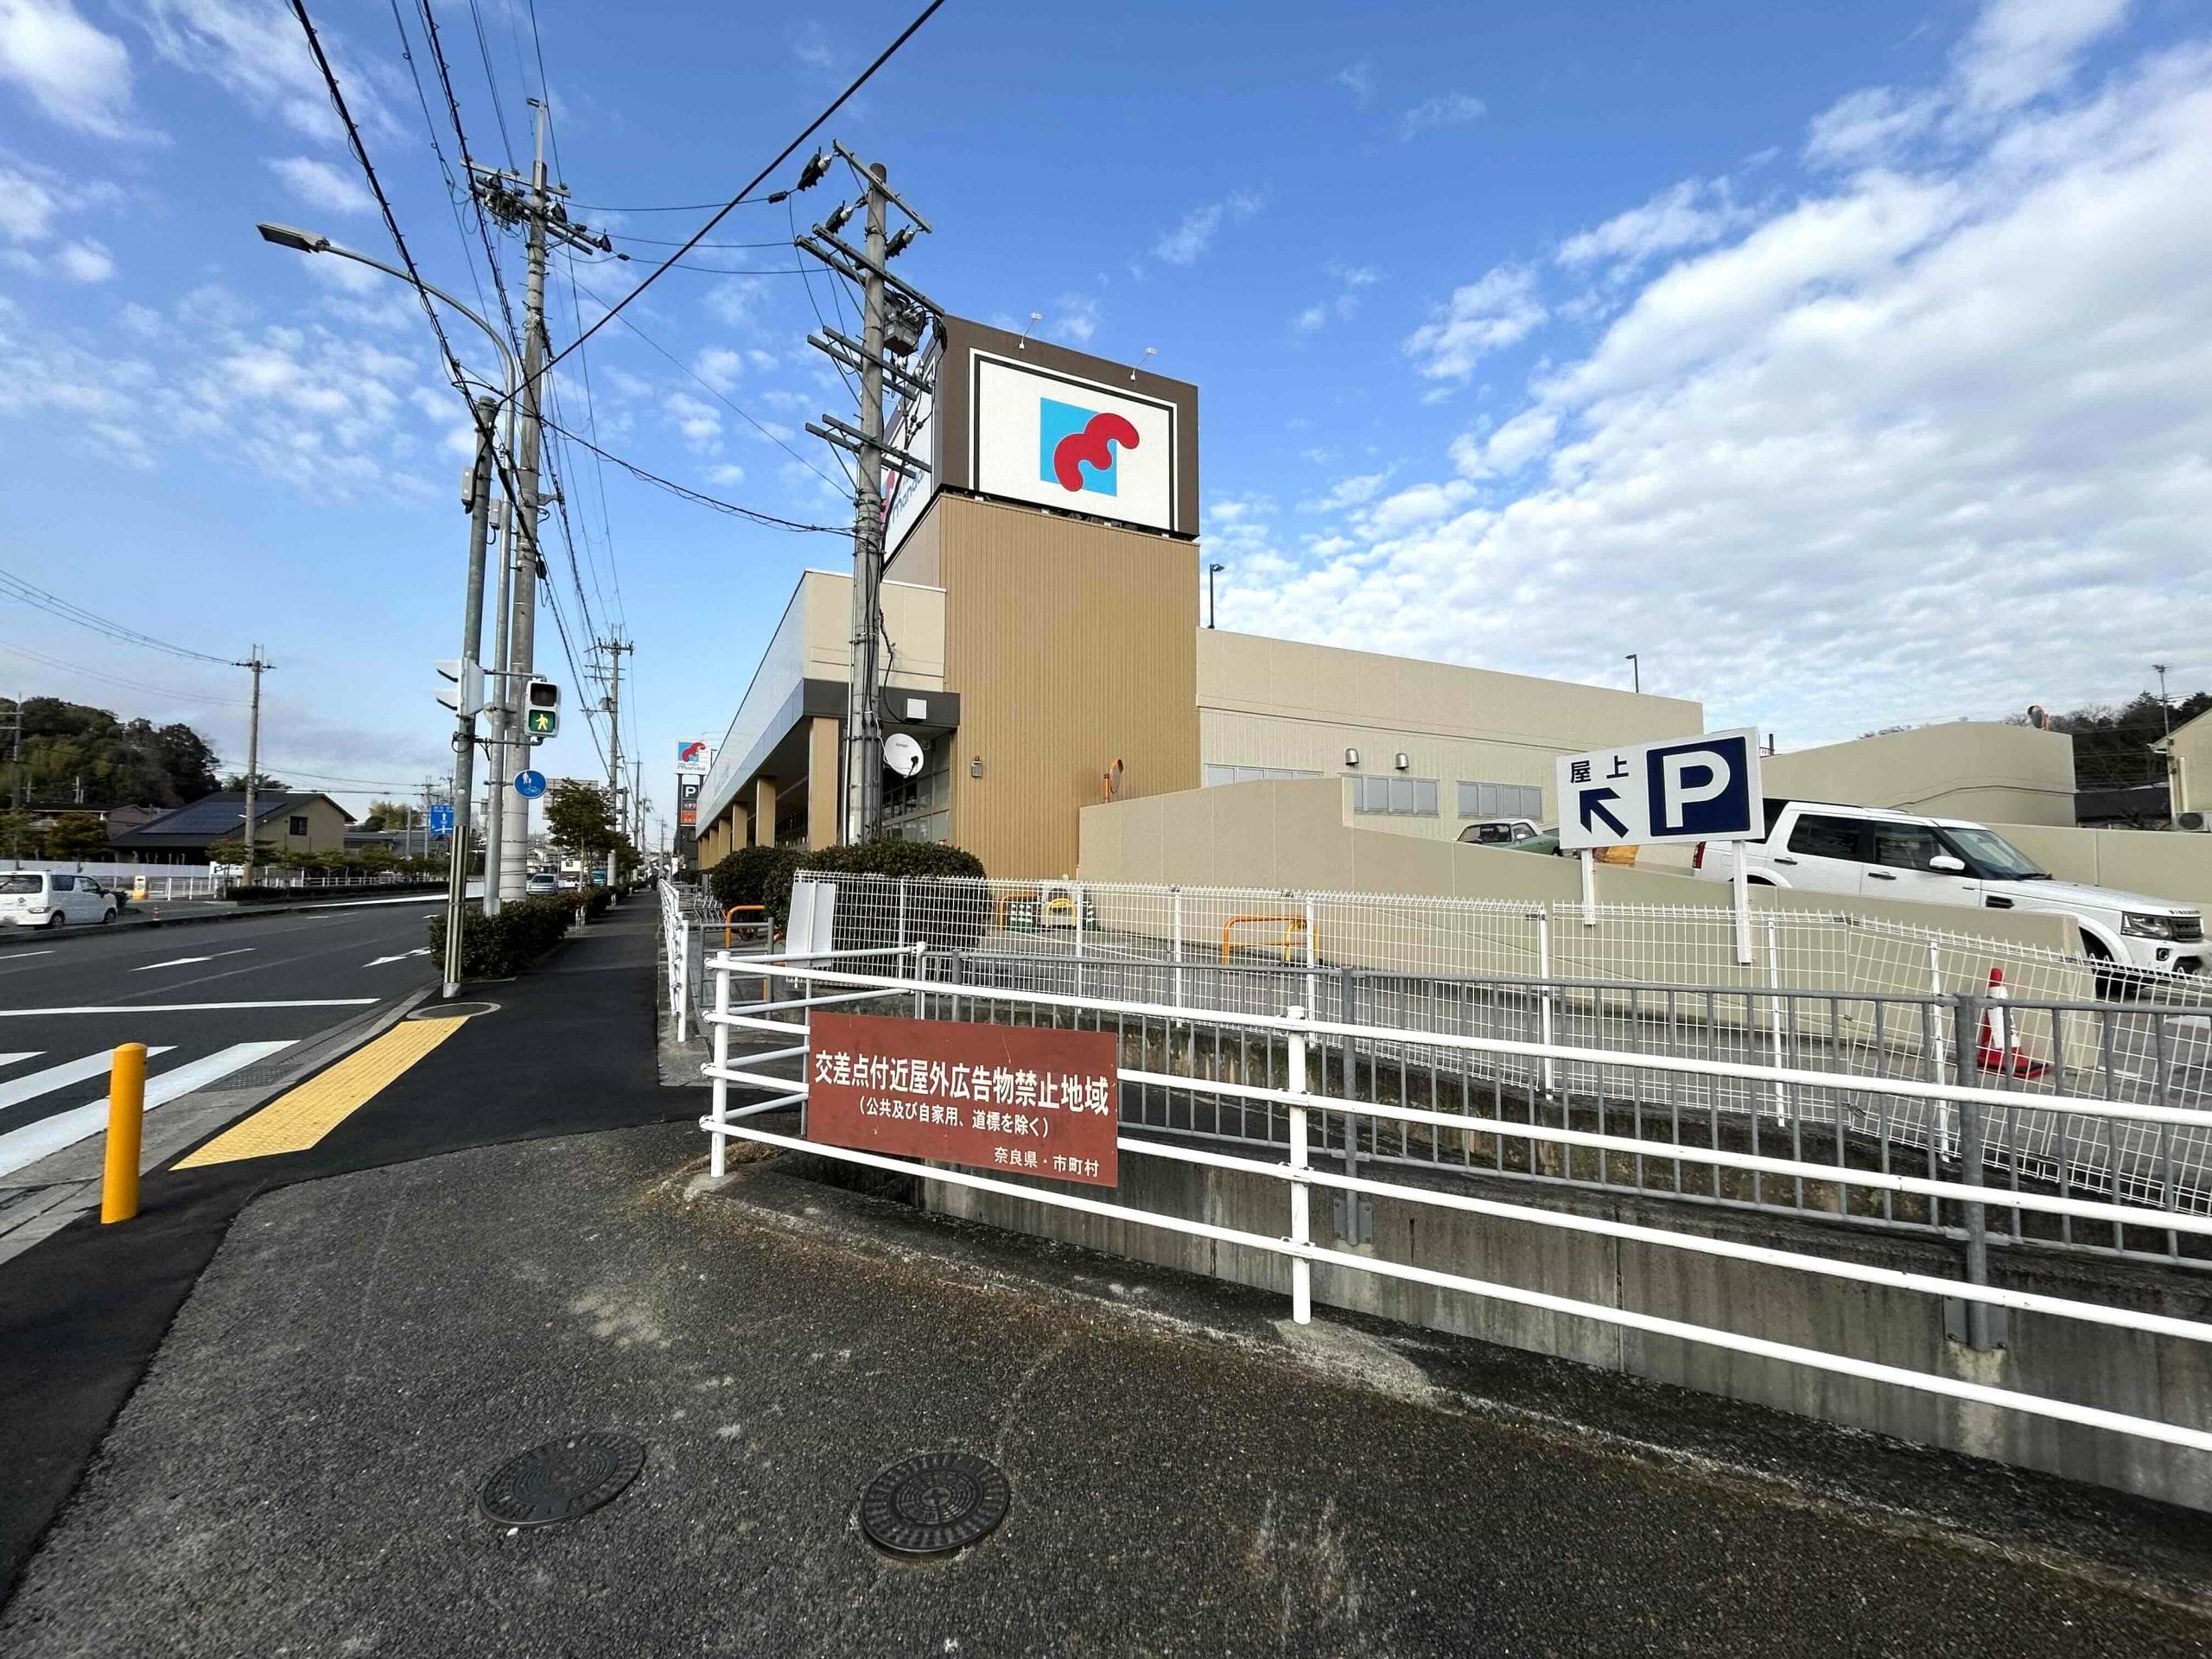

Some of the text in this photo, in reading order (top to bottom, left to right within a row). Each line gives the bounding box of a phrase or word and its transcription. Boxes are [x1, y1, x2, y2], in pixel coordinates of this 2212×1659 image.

[685, 785, 696, 798] P
[1570, 755, 1629, 784] 屋上
[1662, 750, 1731, 829] P
[815, 1049, 1109, 1116] 交差点付近屋外広告物禁止地域
